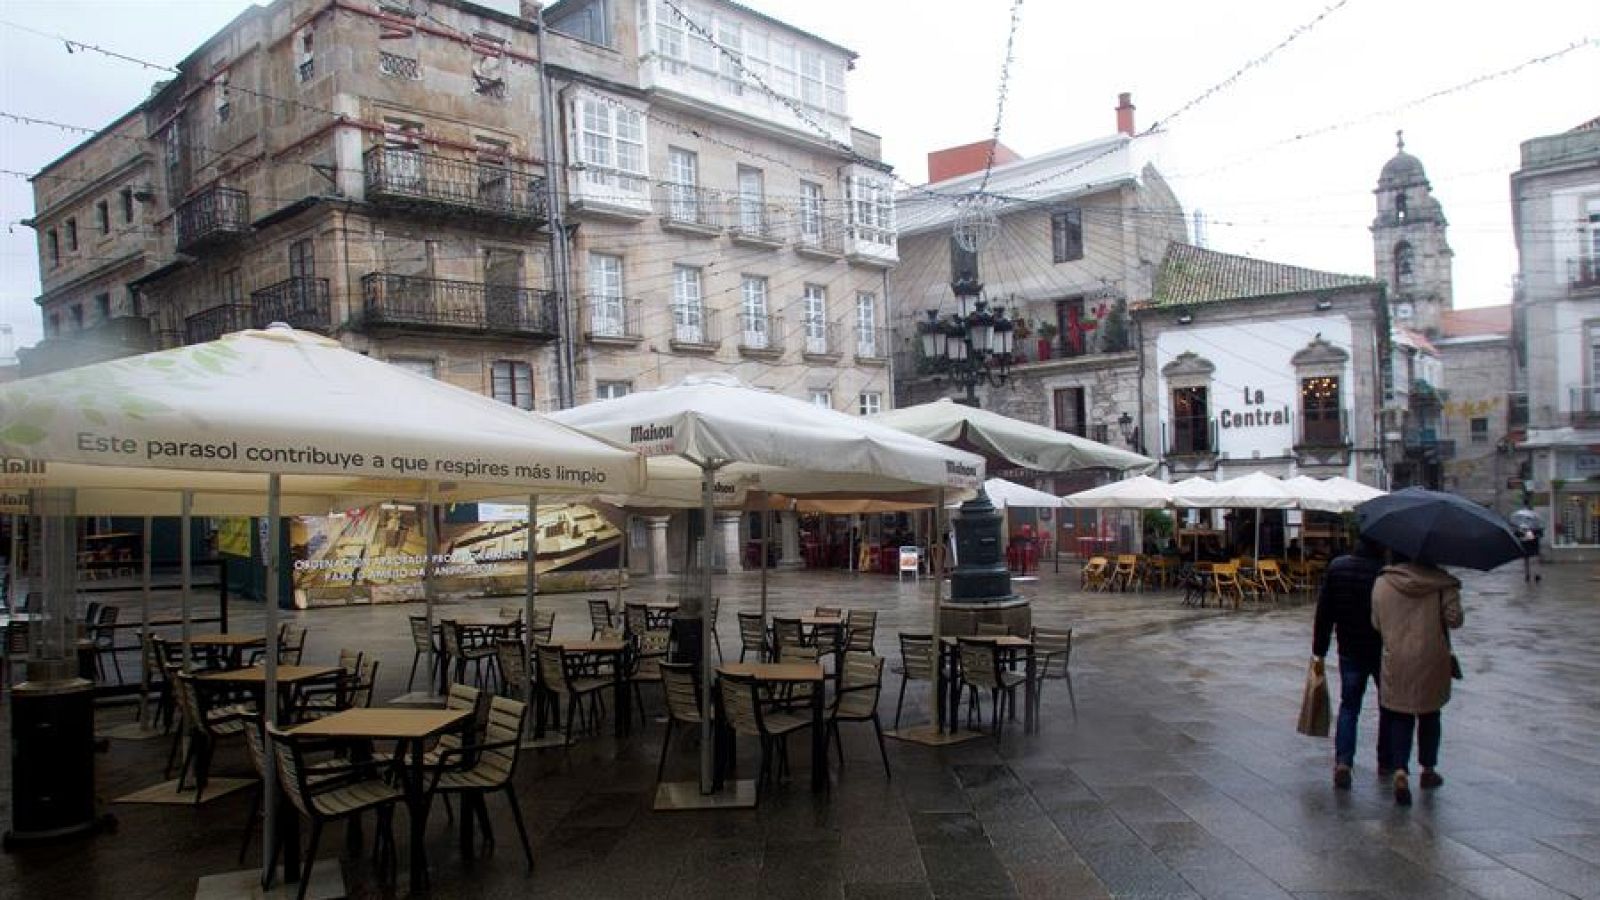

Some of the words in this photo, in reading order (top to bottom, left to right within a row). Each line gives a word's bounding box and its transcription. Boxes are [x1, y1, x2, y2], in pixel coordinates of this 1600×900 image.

[1244, 386, 1264, 405] La
[1221, 405, 1289, 429] Central
[631, 424, 673, 443] Mahou
[77, 432, 137, 454] Este
[146, 440, 237, 460] parasol
[246, 446, 364, 470] contribuye
[372, 454, 385, 468] a
[391, 455, 428, 473] que
[435, 458, 509, 478] respires
[515, 463, 551, 480] más
[556, 465, 607, 485] limpio
